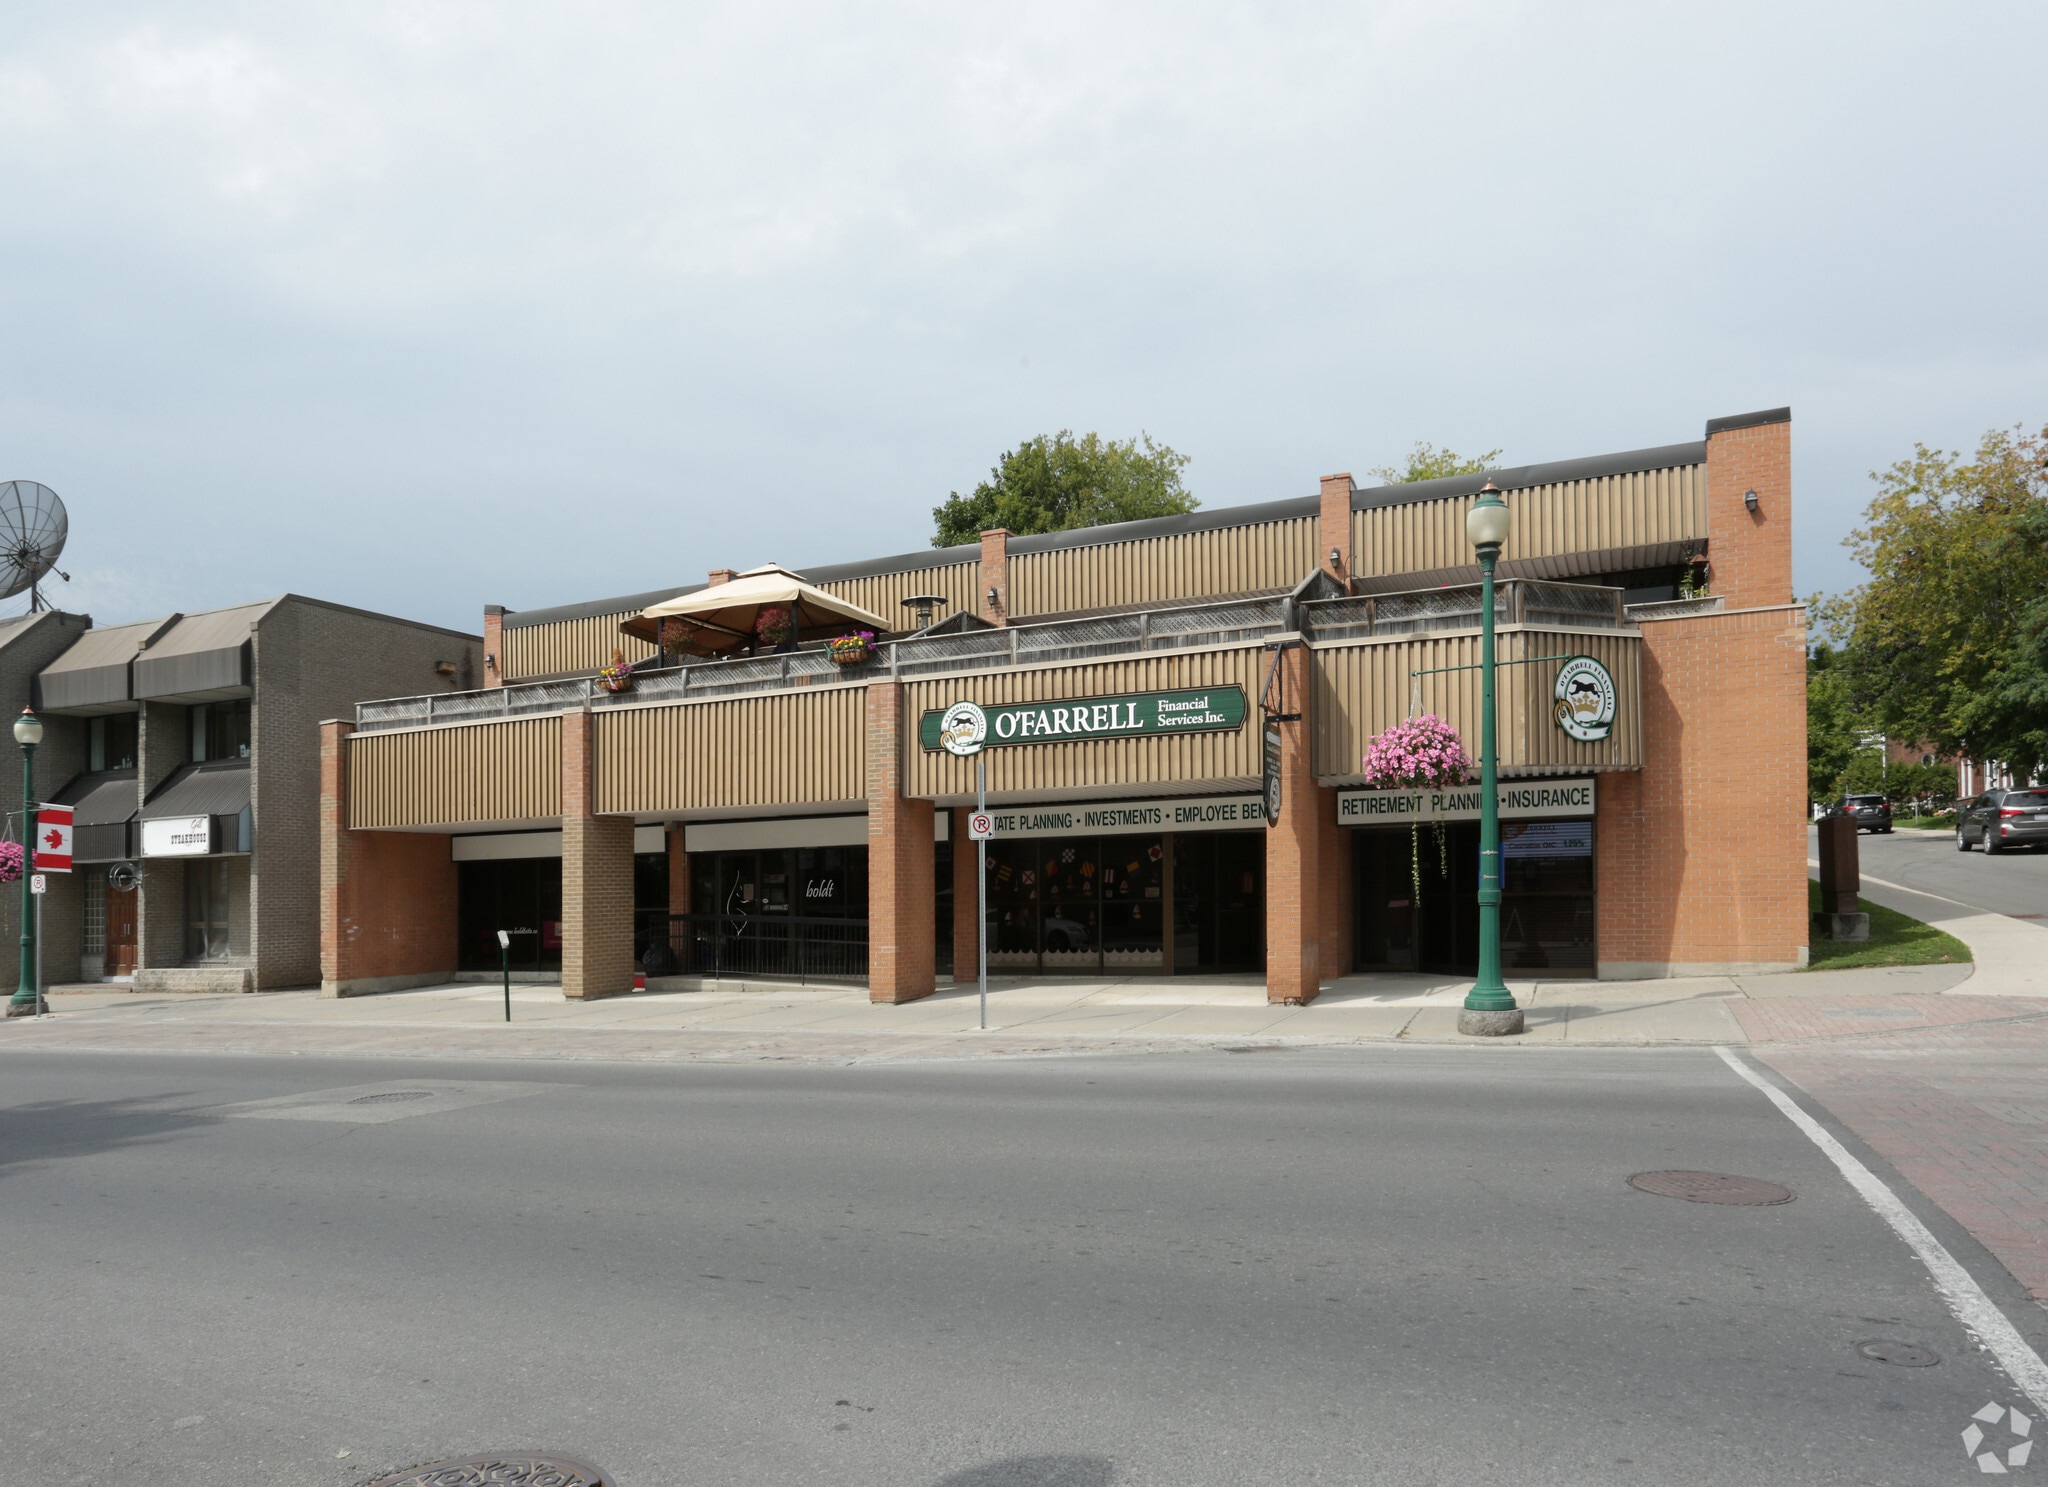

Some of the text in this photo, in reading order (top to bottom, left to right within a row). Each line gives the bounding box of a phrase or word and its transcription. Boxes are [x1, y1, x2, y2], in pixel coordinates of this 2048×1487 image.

[1560, 662, 1612, 711] O'FARRELL FINANCIAL
[1157, 696, 1209, 713] Financial
[994, 702, 1144, 739] O'FARRELL
[1157, 711, 1226, 727] Services Inc.
[1341, 787, 1591, 816] RETIREMENT PLANNI INSURANCE
[994, 802, 1267, 831] TATE PLANNING INVESTMENTS EMPLOYEE BEN
[171, 832, 207, 845] STEAKHOUSE
[805, 879, 834, 898] boldt
